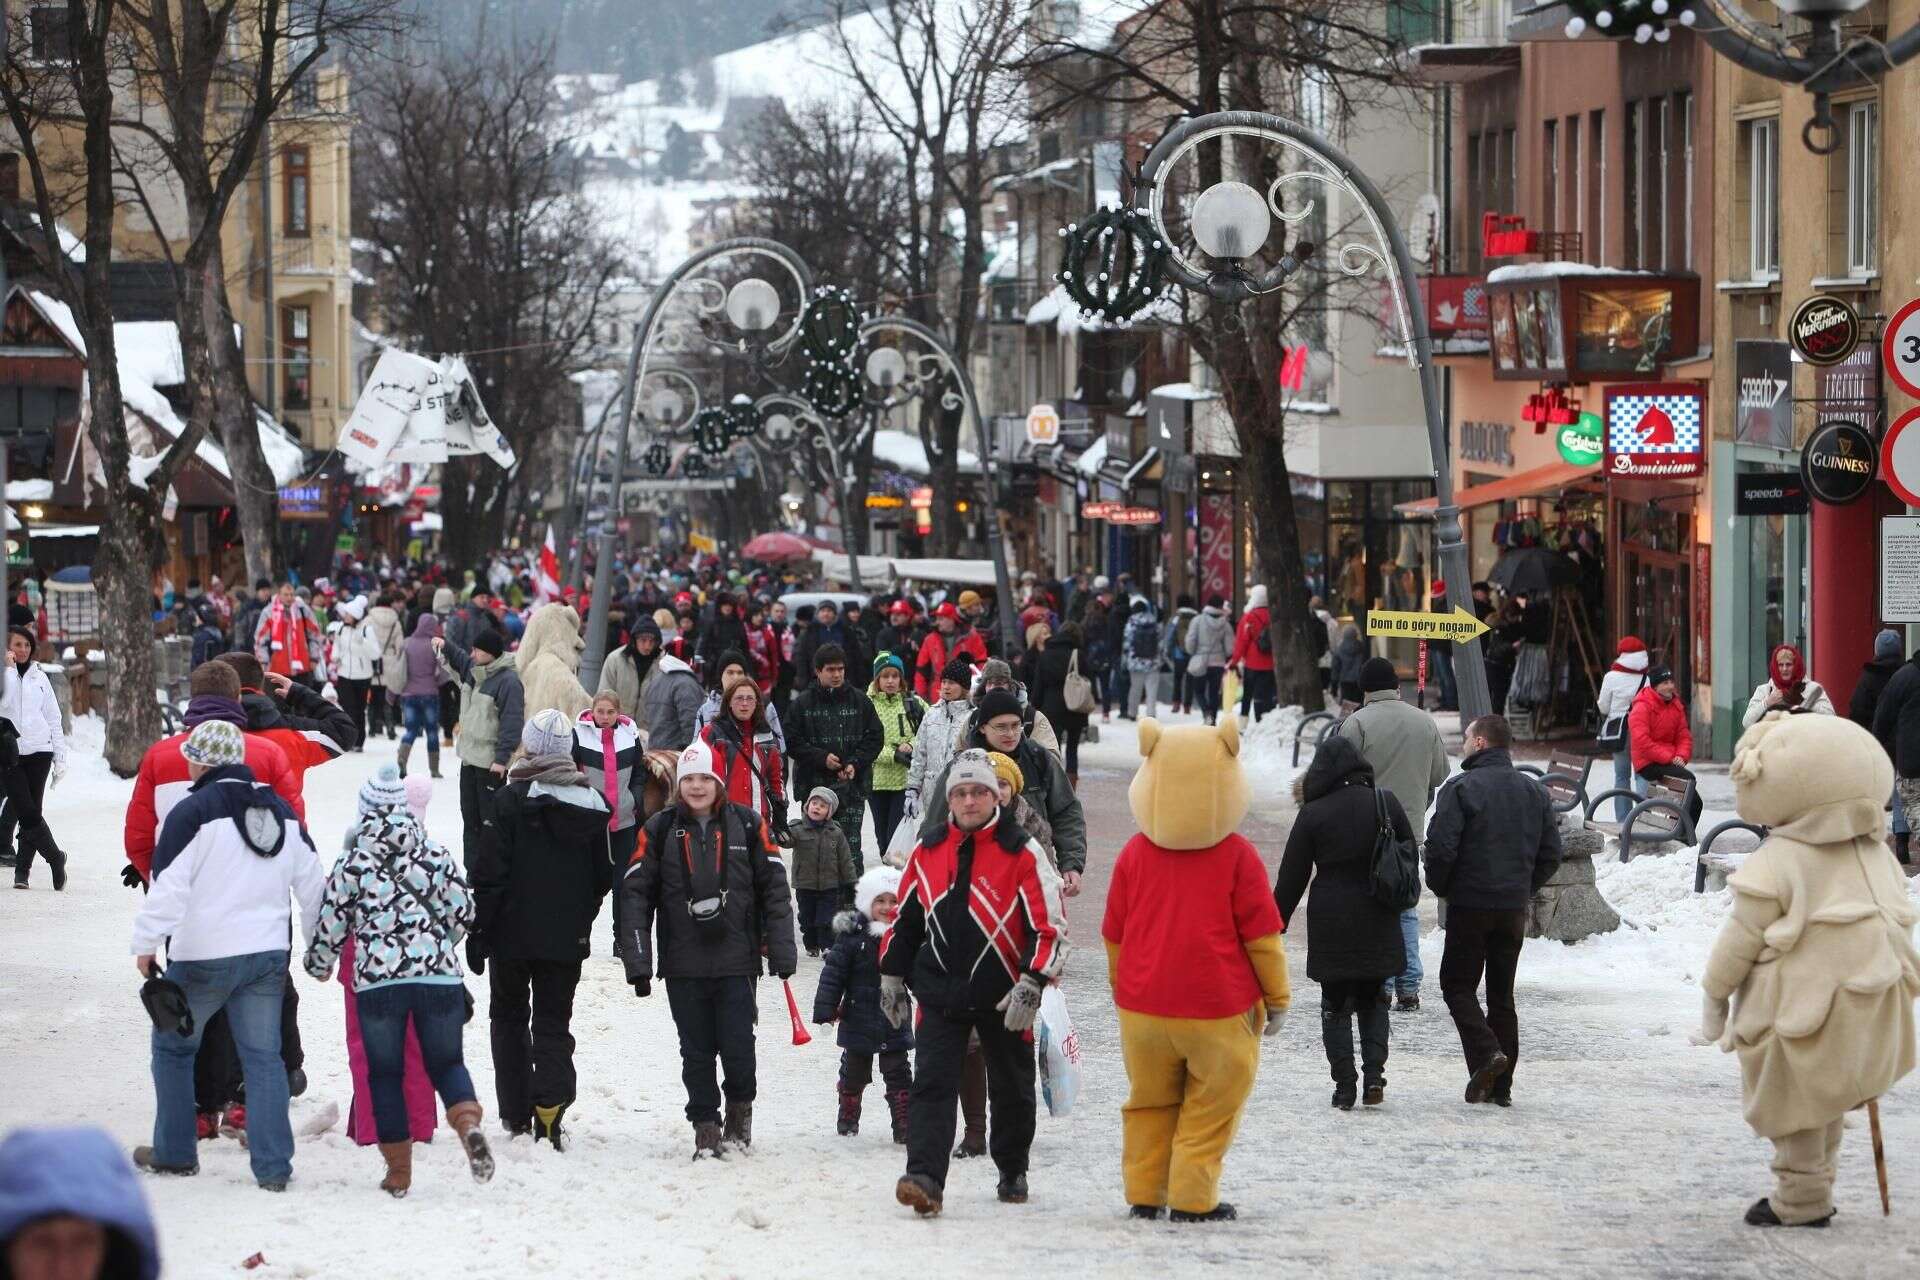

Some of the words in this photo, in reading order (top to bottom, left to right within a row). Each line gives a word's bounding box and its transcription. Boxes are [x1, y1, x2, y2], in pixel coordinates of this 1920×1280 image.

[1741, 369, 1772, 417] speedo
[1611, 454, 1696, 474] Dominium
[1812, 452, 1870, 474] GUINNESS
[1744, 488, 1783, 499] speedo
[1370, 618, 1393, 629] Dom
[1396, 619, 1409, 630] do
[1411, 619, 1436, 632] góry
[1439, 622, 1477, 633] nogami
